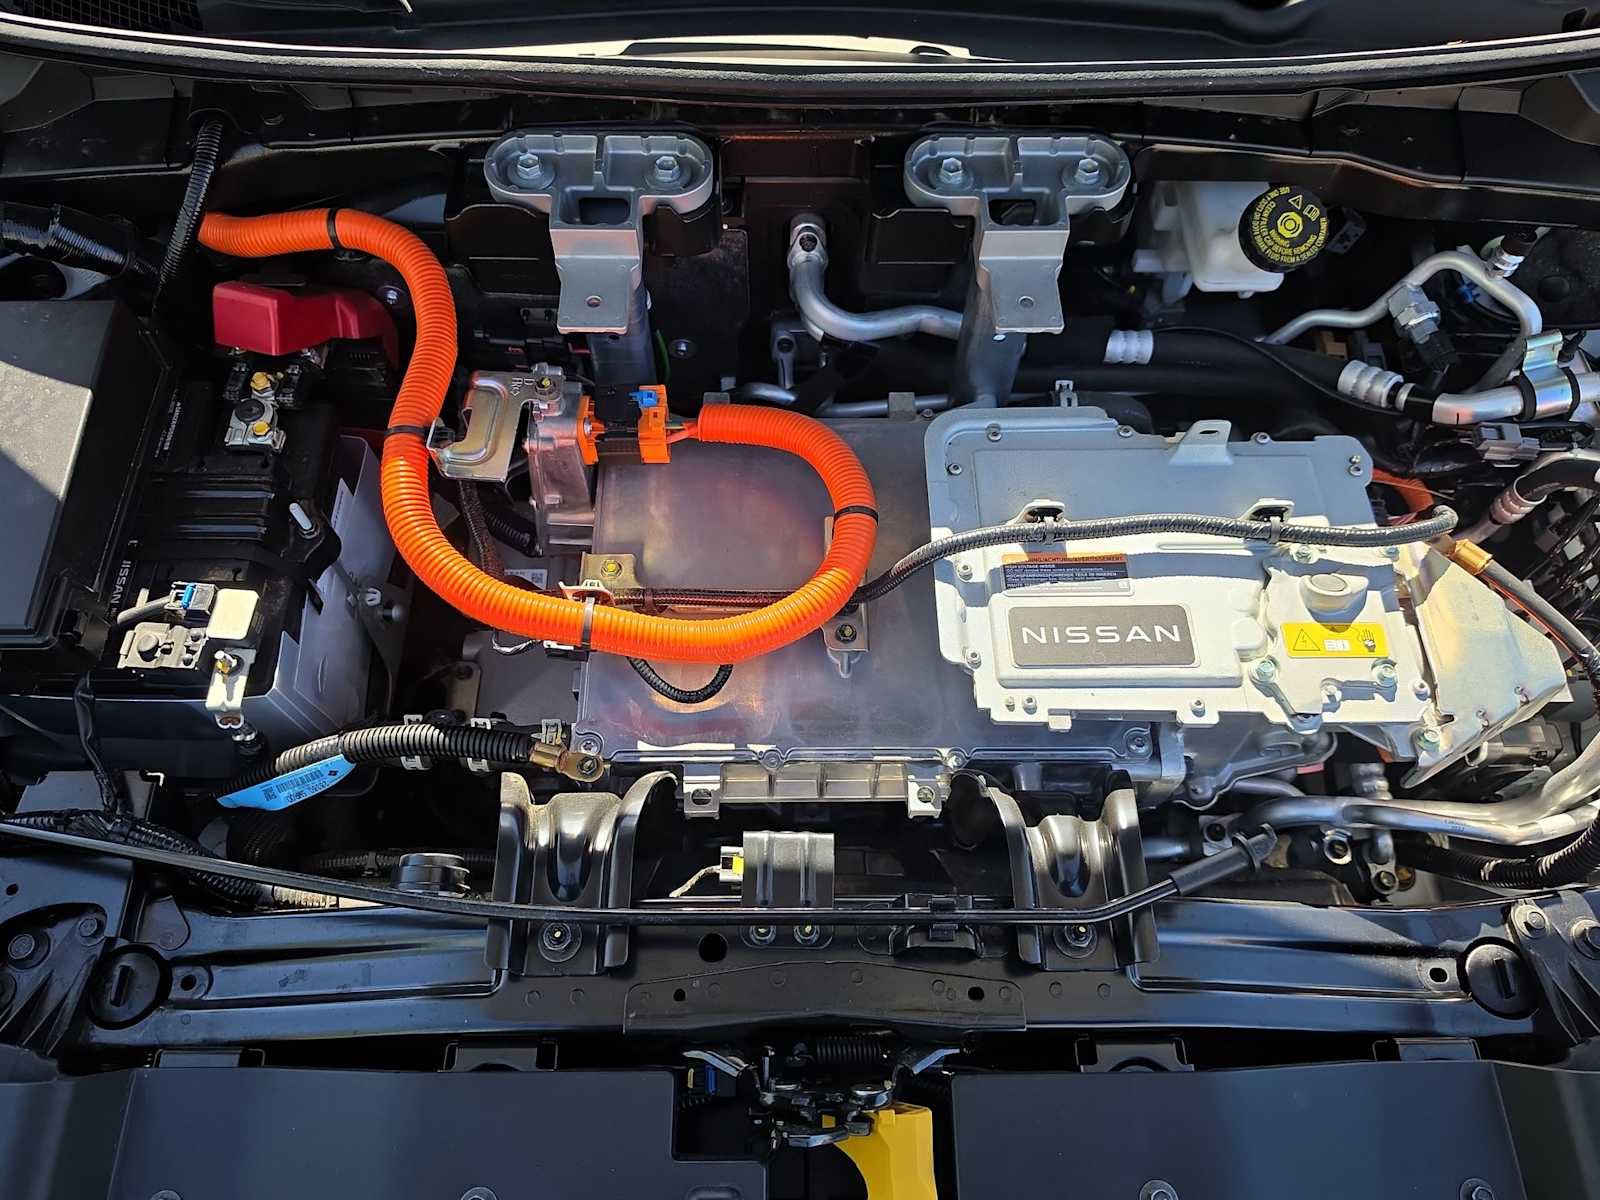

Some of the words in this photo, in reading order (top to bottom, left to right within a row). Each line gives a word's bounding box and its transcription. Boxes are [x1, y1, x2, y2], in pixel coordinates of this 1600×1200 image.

[1265, 249, 1281, 261] FLUID
[1280, 256, 1296, 264] FROM
[1300, 245, 1319, 260] SEALED
[1271, 244, 1294, 256] BEFORE
[1293, 233, 1318, 255] REMOVING
[1021, 624, 1182, 644] NISSAN
